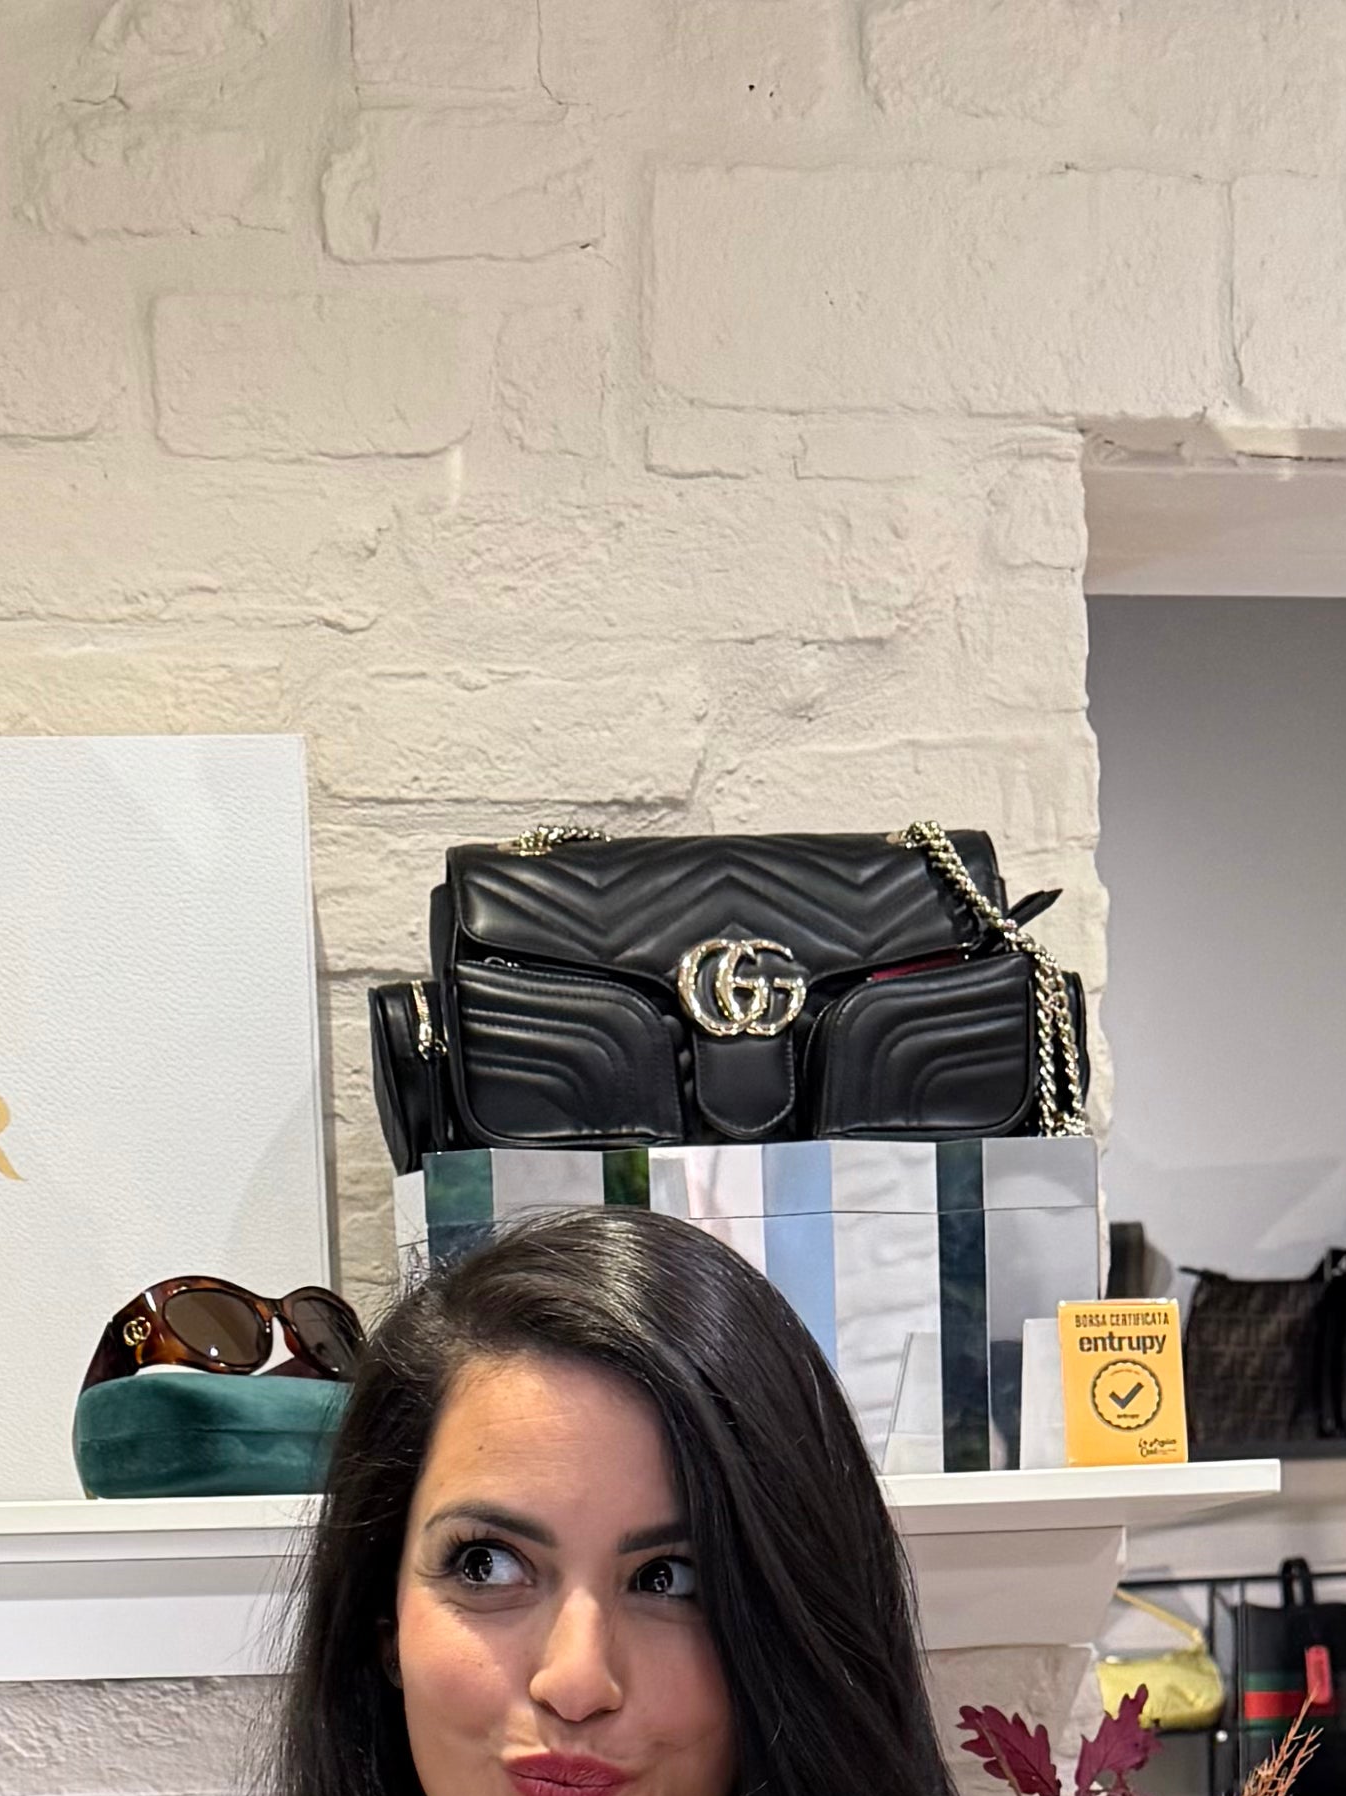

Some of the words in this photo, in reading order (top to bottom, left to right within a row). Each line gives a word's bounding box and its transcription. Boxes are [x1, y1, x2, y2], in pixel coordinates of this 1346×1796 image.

[1074, 1313, 1108, 1328] BORSA
[1110, 1311, 1170, 1328] CERTIFICATA
[1078, 1331, 1167, 1355] entrupy
